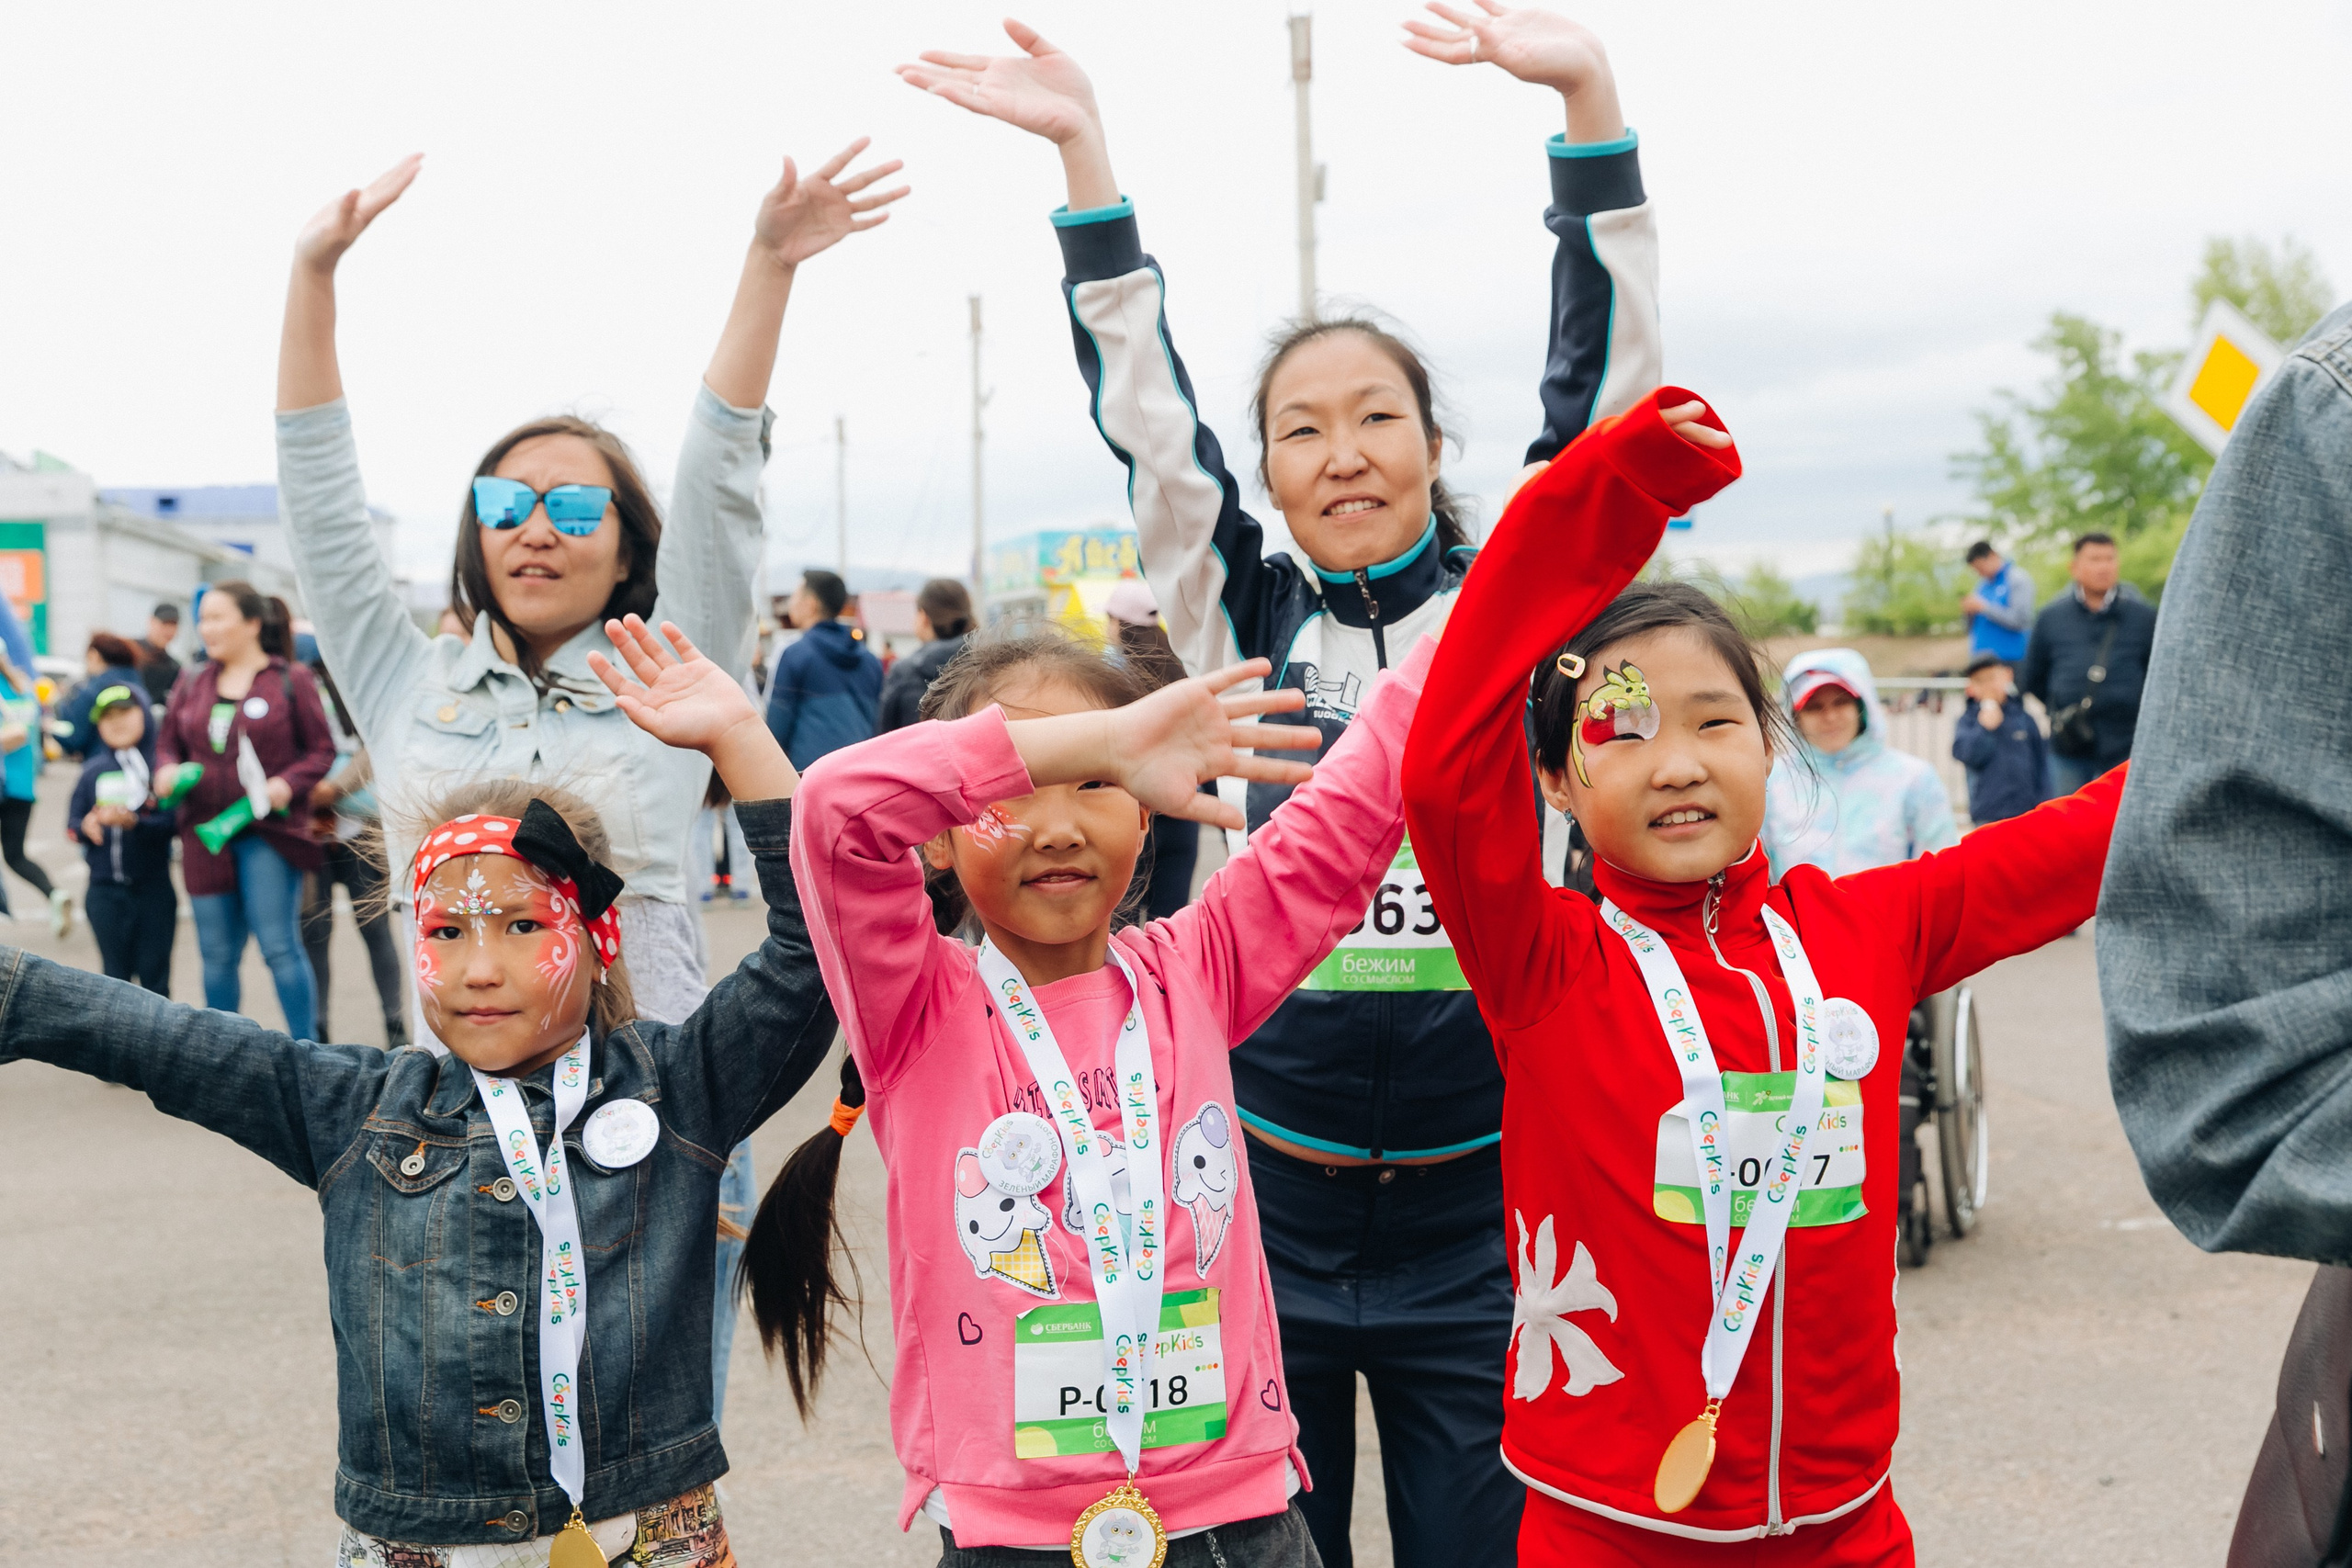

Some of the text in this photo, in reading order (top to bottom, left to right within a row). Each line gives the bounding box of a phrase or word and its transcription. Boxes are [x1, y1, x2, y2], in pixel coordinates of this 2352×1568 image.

[1348, 883, 1442, 935] 63
[1342, 953, 1416, 973] бежим
[1046, 1321, 1092, 1332] СБЕРБАНК
